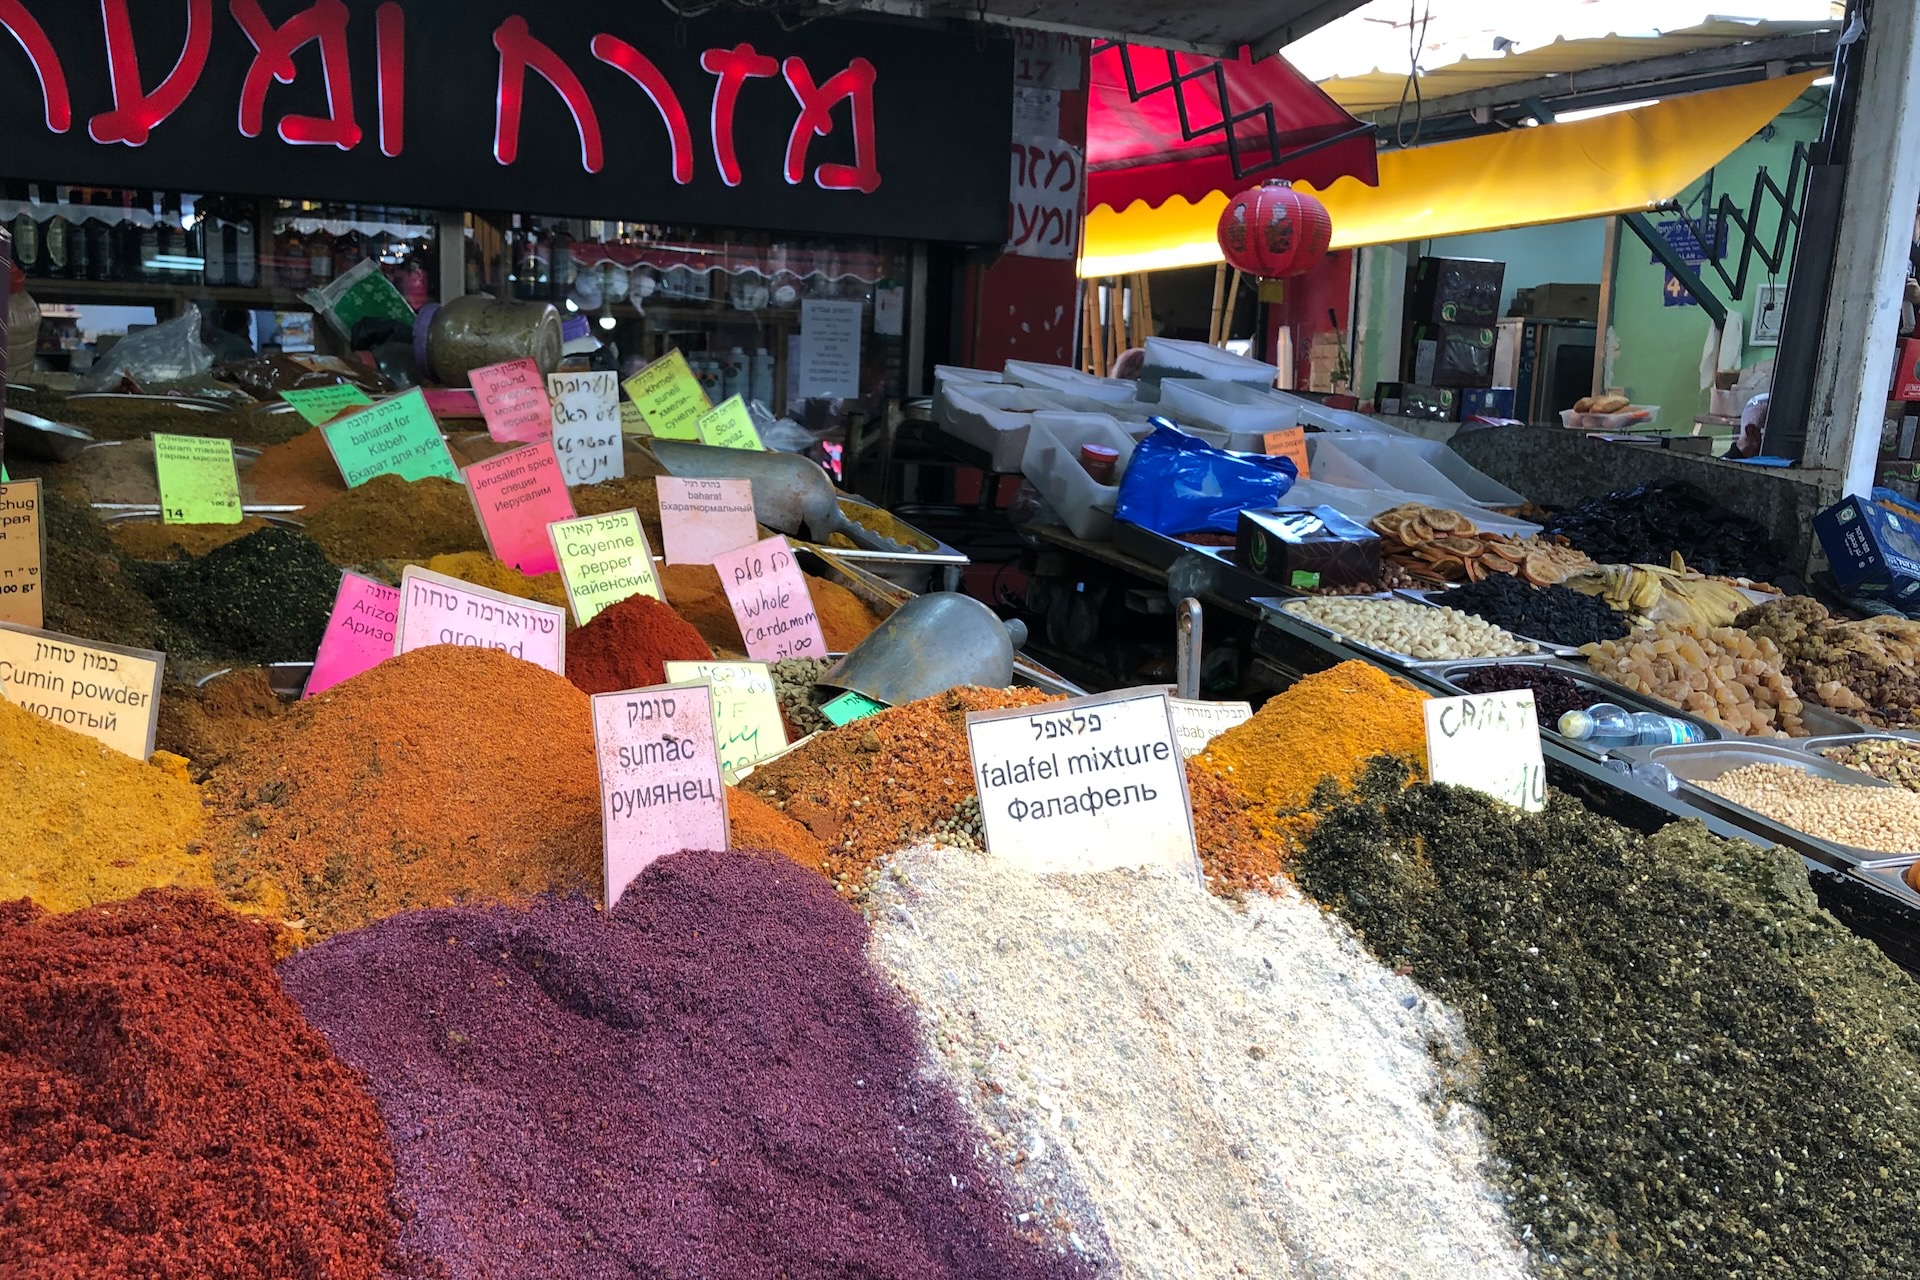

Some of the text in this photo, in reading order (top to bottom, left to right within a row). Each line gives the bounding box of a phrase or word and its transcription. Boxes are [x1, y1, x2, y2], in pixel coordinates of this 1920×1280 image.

[1016, 58, 1052, 81] 17
[493, 15, 882, 192] מזרח
[490, 373, 527, 393] ground
[350, 414, 412, 446] baharat for
[715, 418, 736, 437] Soup
[158, 443, 230, 455] Garam masala
[367, 433, 409, 457] Kibbeh
[390, 448, 413, 467] для
[414, 437, 442, 456] кубе
[515, 447, 539, 463] תבלין
[476, 466, 526, 490] Jerusalem
[527, 456, 554, 473] spice
[500, 477, 537, 496] специи
[494, 486, 552, 512] Иерусалим
[688, 491, 722, 500] baharat
[165, 508, 184, 518] 14
[561, 513, 629, 540] פלפל קאיין
[567, 536, 635, 557] Cayenne
[580, 556, 632, 578] pepper
[573, 570, 653, 597] кайенский
[352, 599, 399, 624] Arizo
[413, 584, 554, 634] שווארמה טחון
[742, 586, 790, 618] Whole
[35, 642, 118, 671] כמון טחון
[0, 660, 149, 708] Cumin powder
[20, 700, 117, 732] молотый
[626, 698, 676, 728] סומק
[1030, 710, 1102, 741] פלאפל
[1183, 707, 1212, 719] מזרחי
[1214, 705, 1247, 720] תבלין
[619, 738, 695, 768] sumac
[980, 740, 1170, 788] falafel mixture
[611, 778, 715, 820] румянец
[1007, 773, 1158, 823] Фалафель
